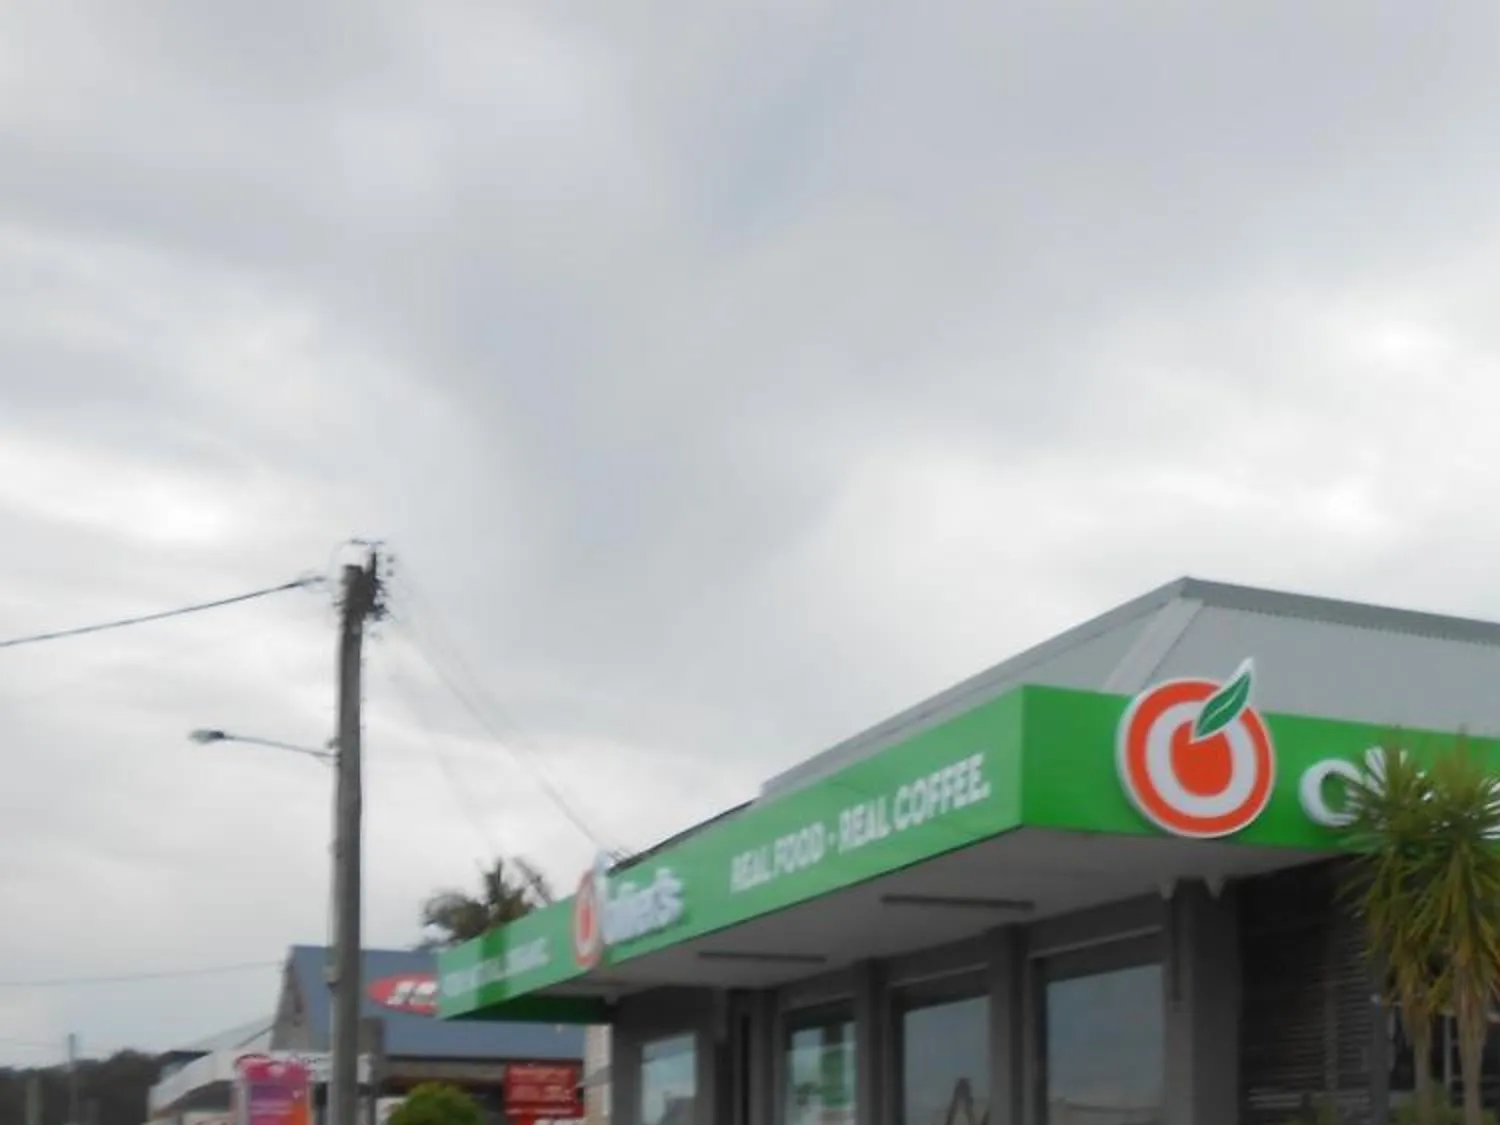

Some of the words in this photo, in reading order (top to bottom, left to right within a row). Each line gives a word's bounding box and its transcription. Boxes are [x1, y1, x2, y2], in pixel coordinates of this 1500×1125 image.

[730, 843, 773, 895] REAL
[772, 820, 826, 878] FOOD
[837, 794, 892, 856] REAL
